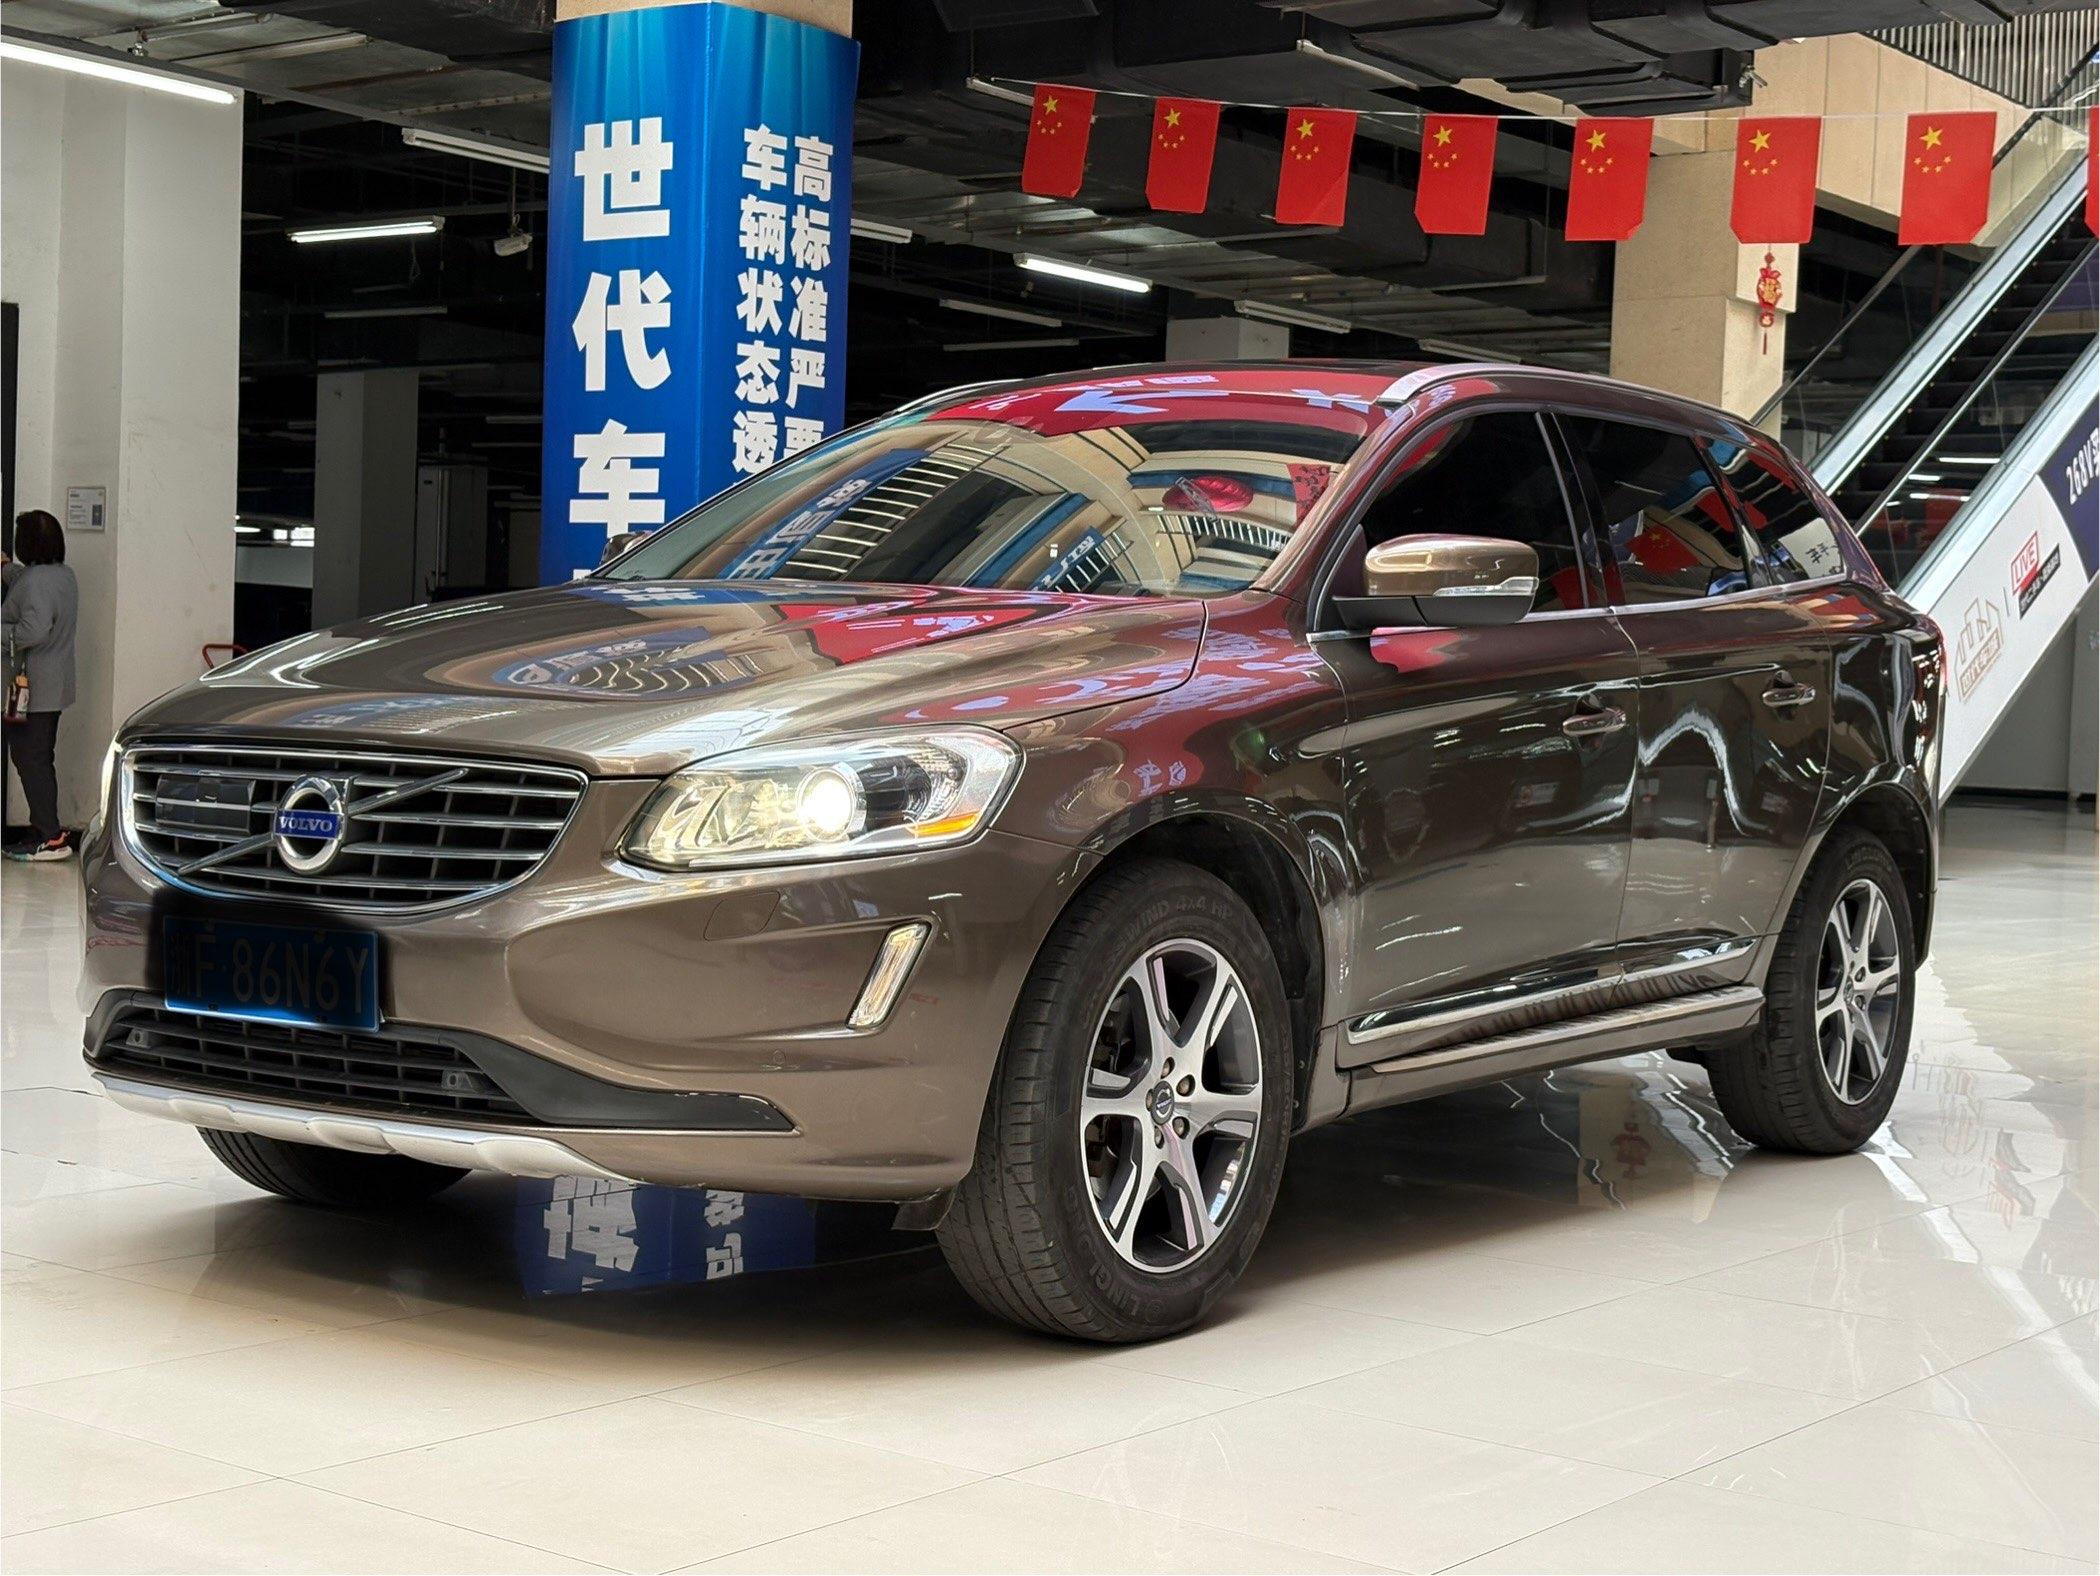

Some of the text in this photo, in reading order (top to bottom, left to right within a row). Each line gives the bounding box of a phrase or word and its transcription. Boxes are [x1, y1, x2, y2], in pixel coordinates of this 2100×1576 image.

[569, 116, 674, 580] 世代车
[732, 124, 788, 474] 车辆状态透
[2013, 542, 2035, 584] LIVE
[278, 816, 333, 832] VOLVO
